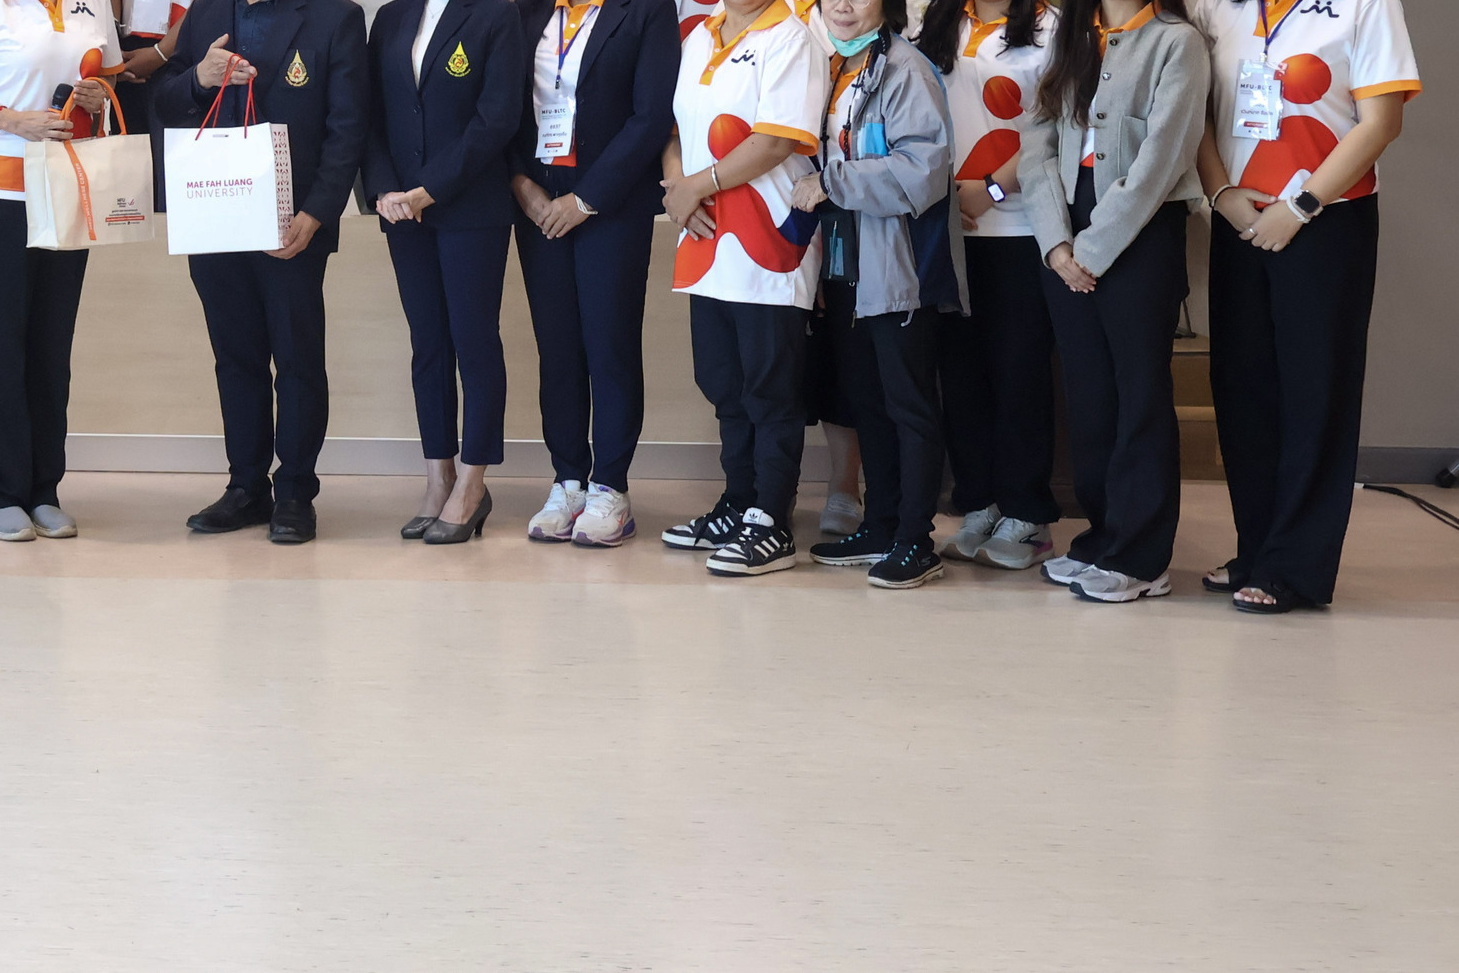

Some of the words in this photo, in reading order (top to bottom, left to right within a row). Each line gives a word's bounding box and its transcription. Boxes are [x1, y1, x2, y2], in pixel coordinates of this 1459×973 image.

[1240, 83, 1272, 91] MFU-BLC
[186, 180, 204, 188] MAE
[205, 179, 222, 187] FAH
[223, 178, 253, 187] LUANG
[186, 186, 253, 199] UNIVERSITY
